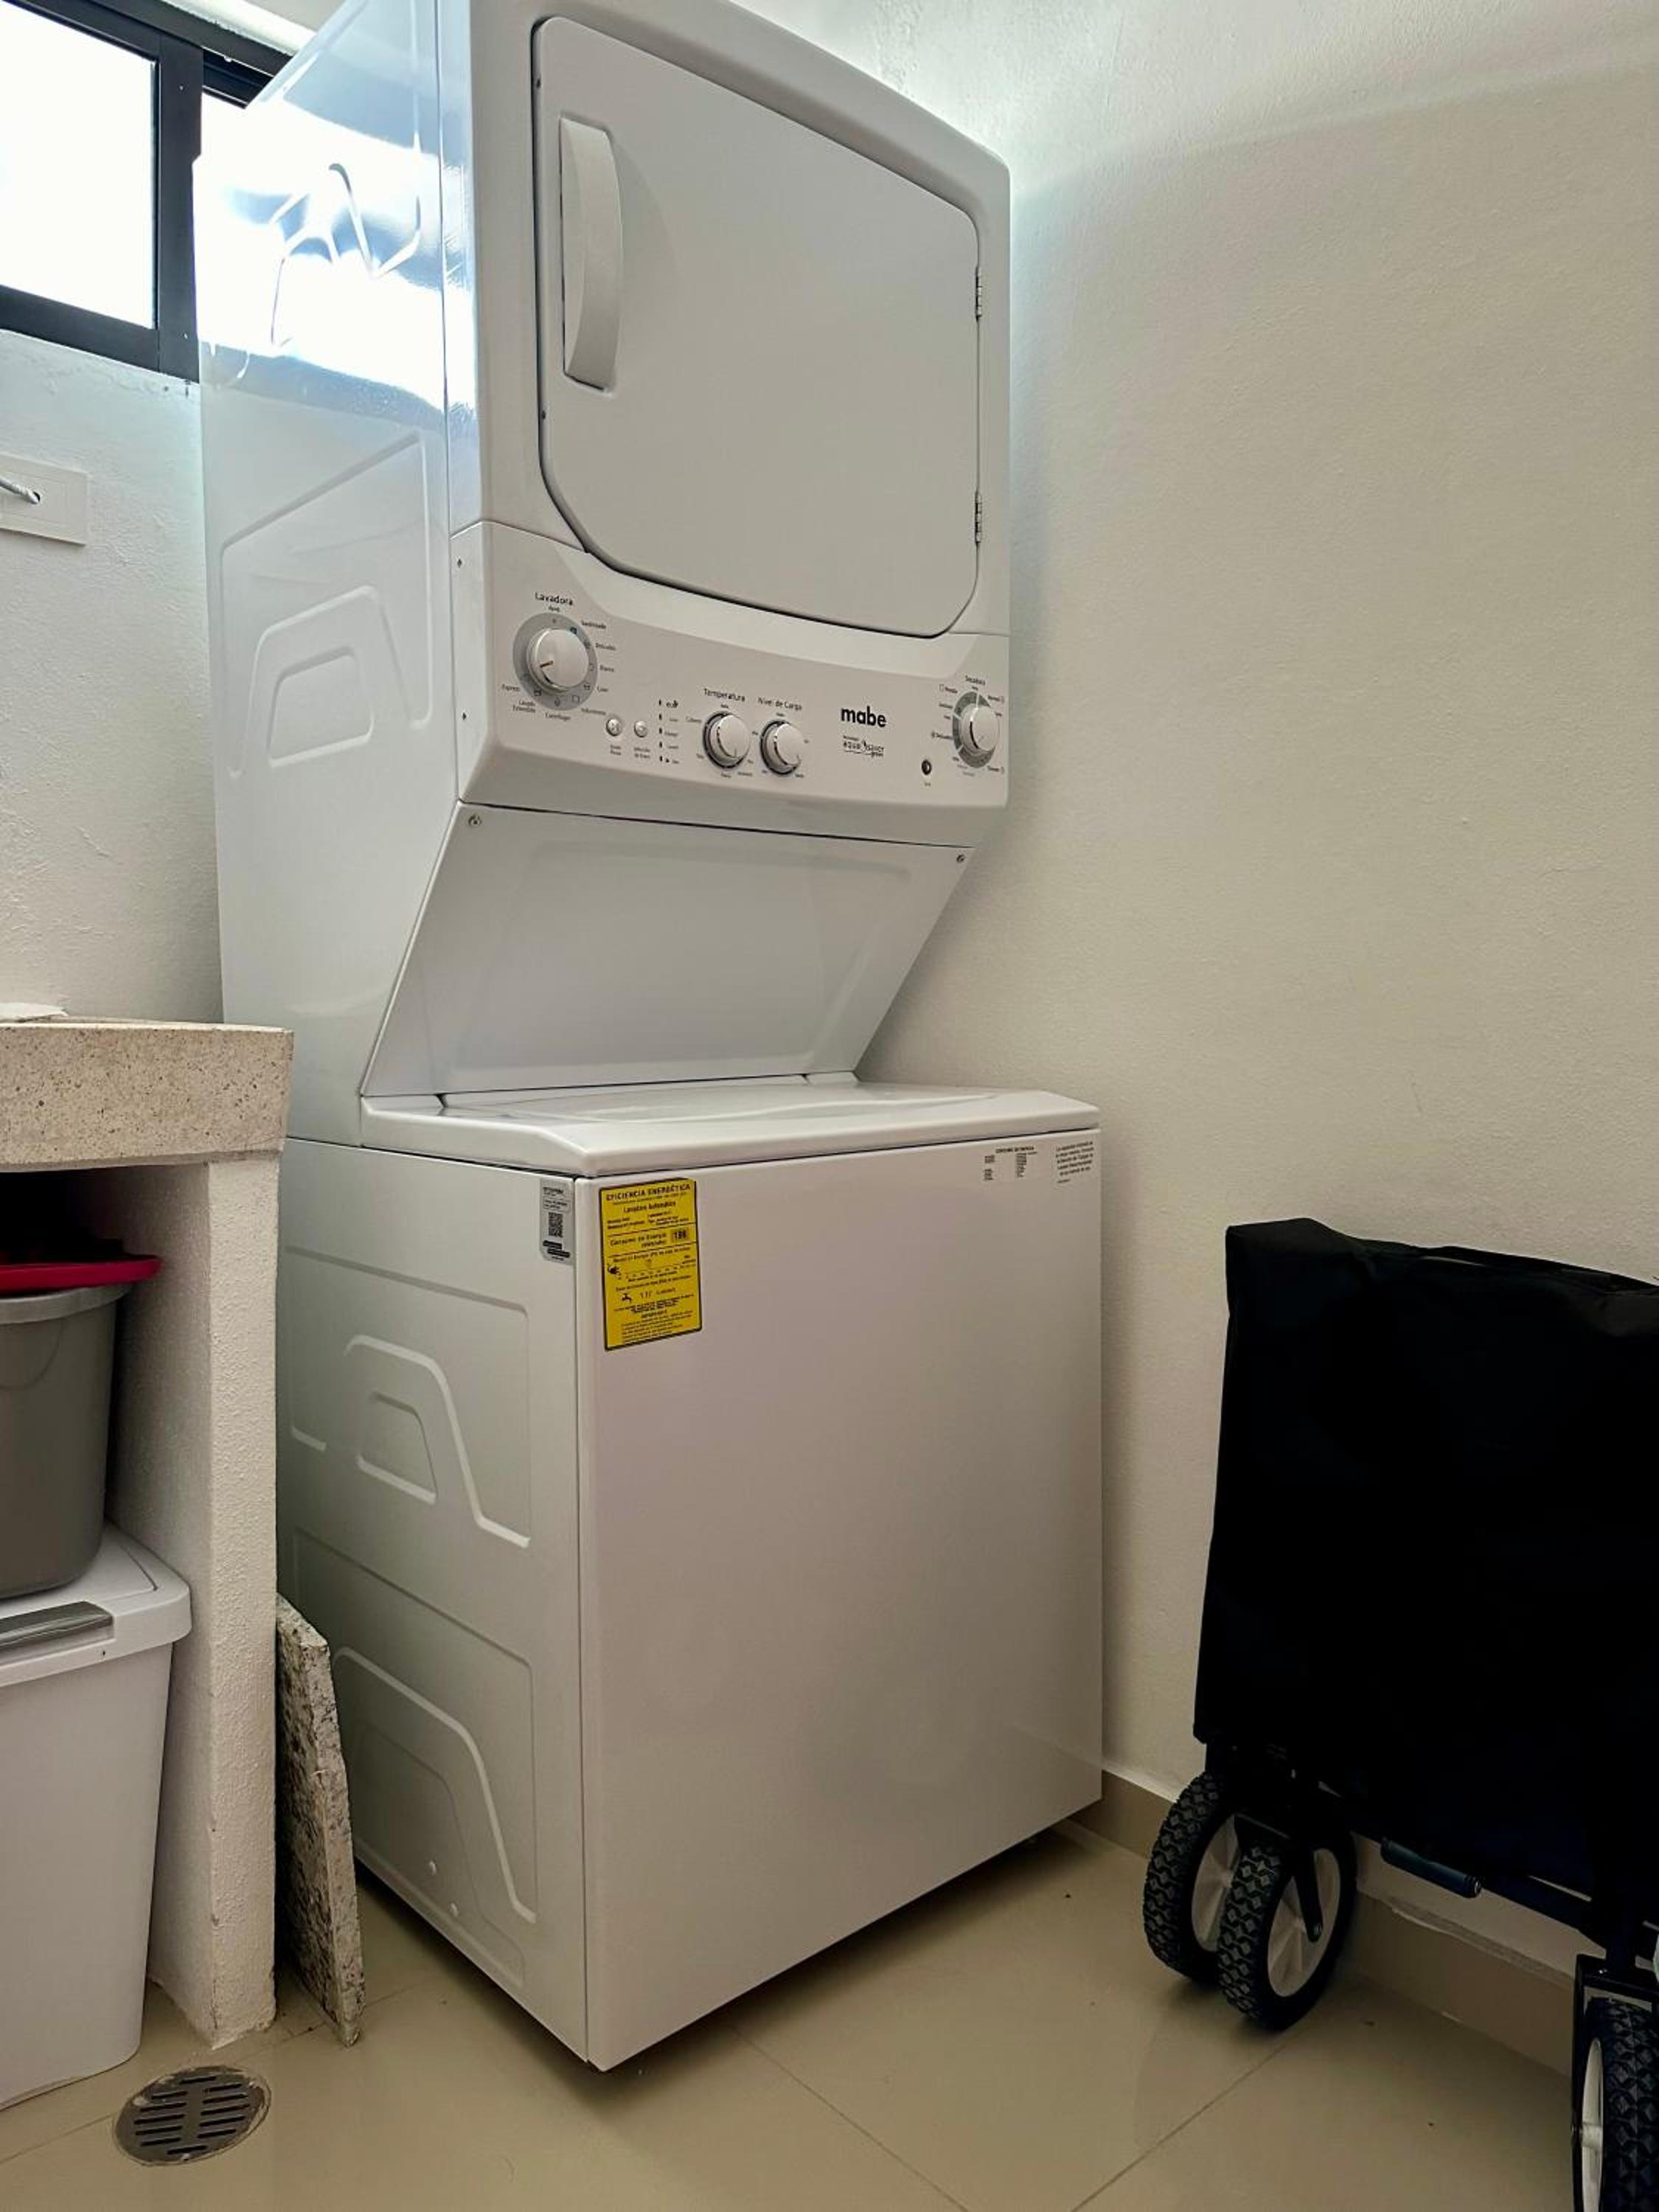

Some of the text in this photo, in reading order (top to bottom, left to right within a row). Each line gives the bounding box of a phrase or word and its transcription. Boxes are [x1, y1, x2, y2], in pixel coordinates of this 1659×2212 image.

[535, 591, 574, 606] Lavadora
[703, 687, 746, 703] Temperatura
[841, 705, 887, 728] mabe
